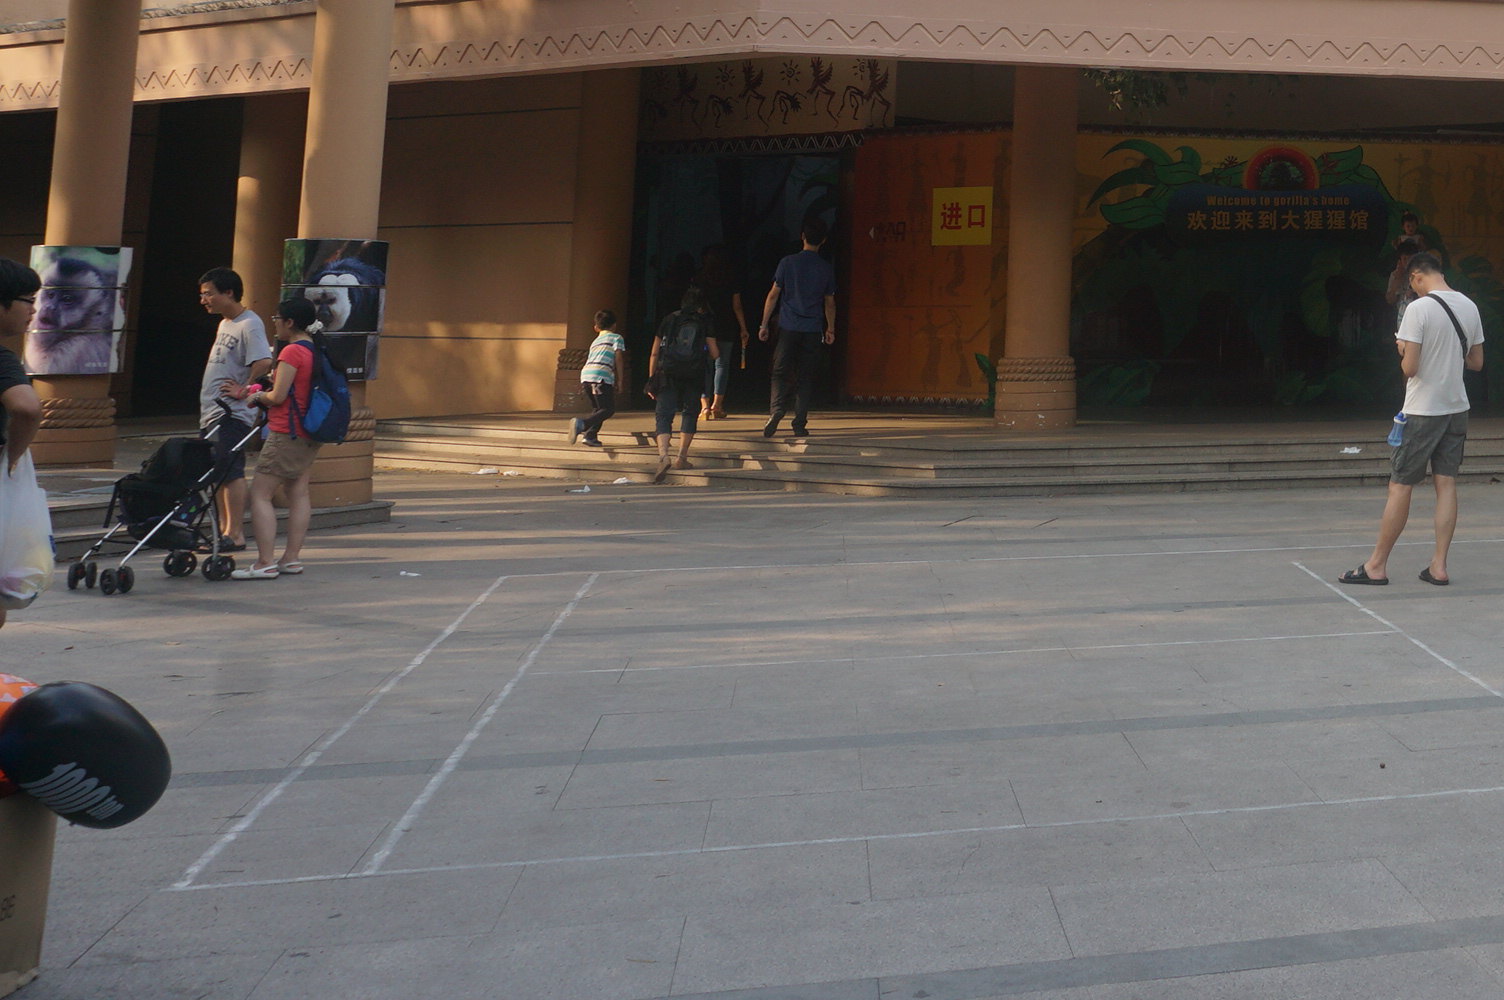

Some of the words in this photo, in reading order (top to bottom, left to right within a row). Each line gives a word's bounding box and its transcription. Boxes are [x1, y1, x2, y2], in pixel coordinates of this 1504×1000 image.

[1206, 195, 1257, 206] Welcome
[1260, 196, 1271, 206] to
[1321, 195, 1350, 206] home
[940, 202, 985, 230] 进口
[1187, 209, 1369, 231] 欢迎来到大猩猩馆
